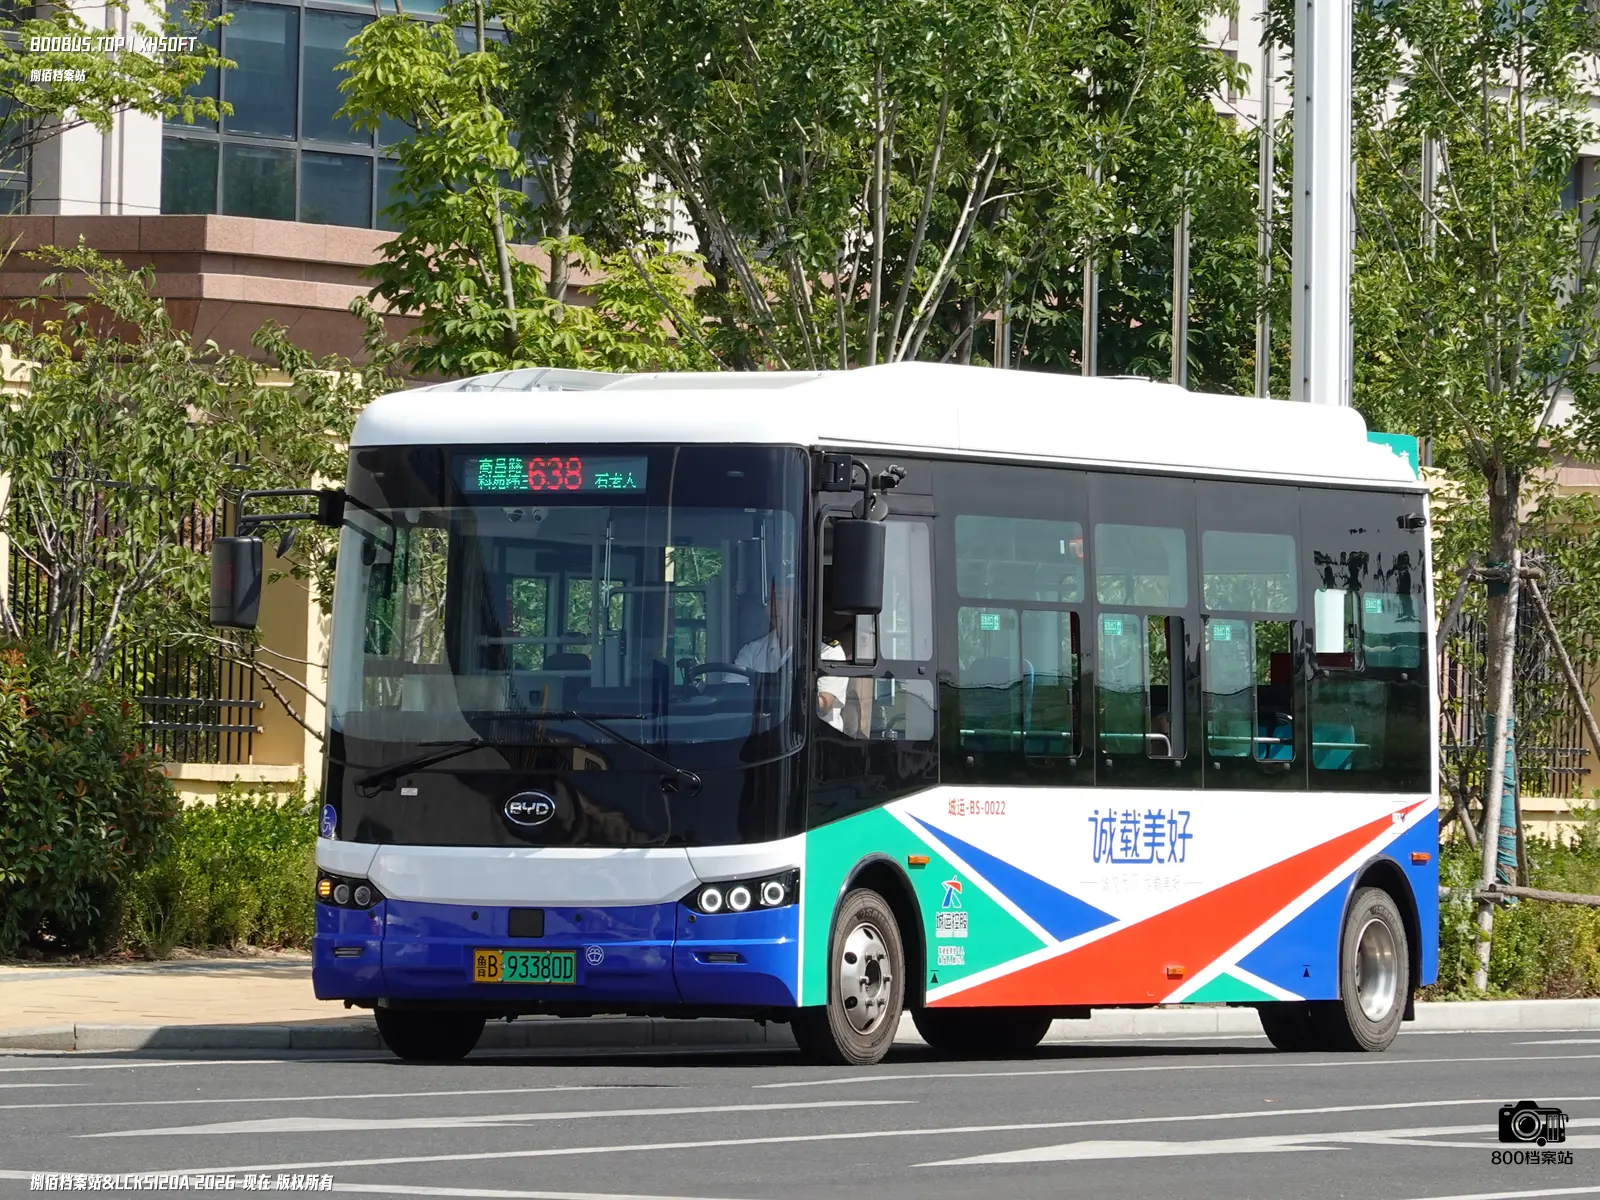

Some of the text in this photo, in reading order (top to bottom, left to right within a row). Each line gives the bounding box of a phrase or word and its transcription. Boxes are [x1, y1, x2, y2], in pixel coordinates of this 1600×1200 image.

[528, 457, 582, 491] 638
[594, 472, 637, 489] 石老人
[510, 801, 549, 815] BYD
[1088, 808, 1193, 864] 诚载美好
